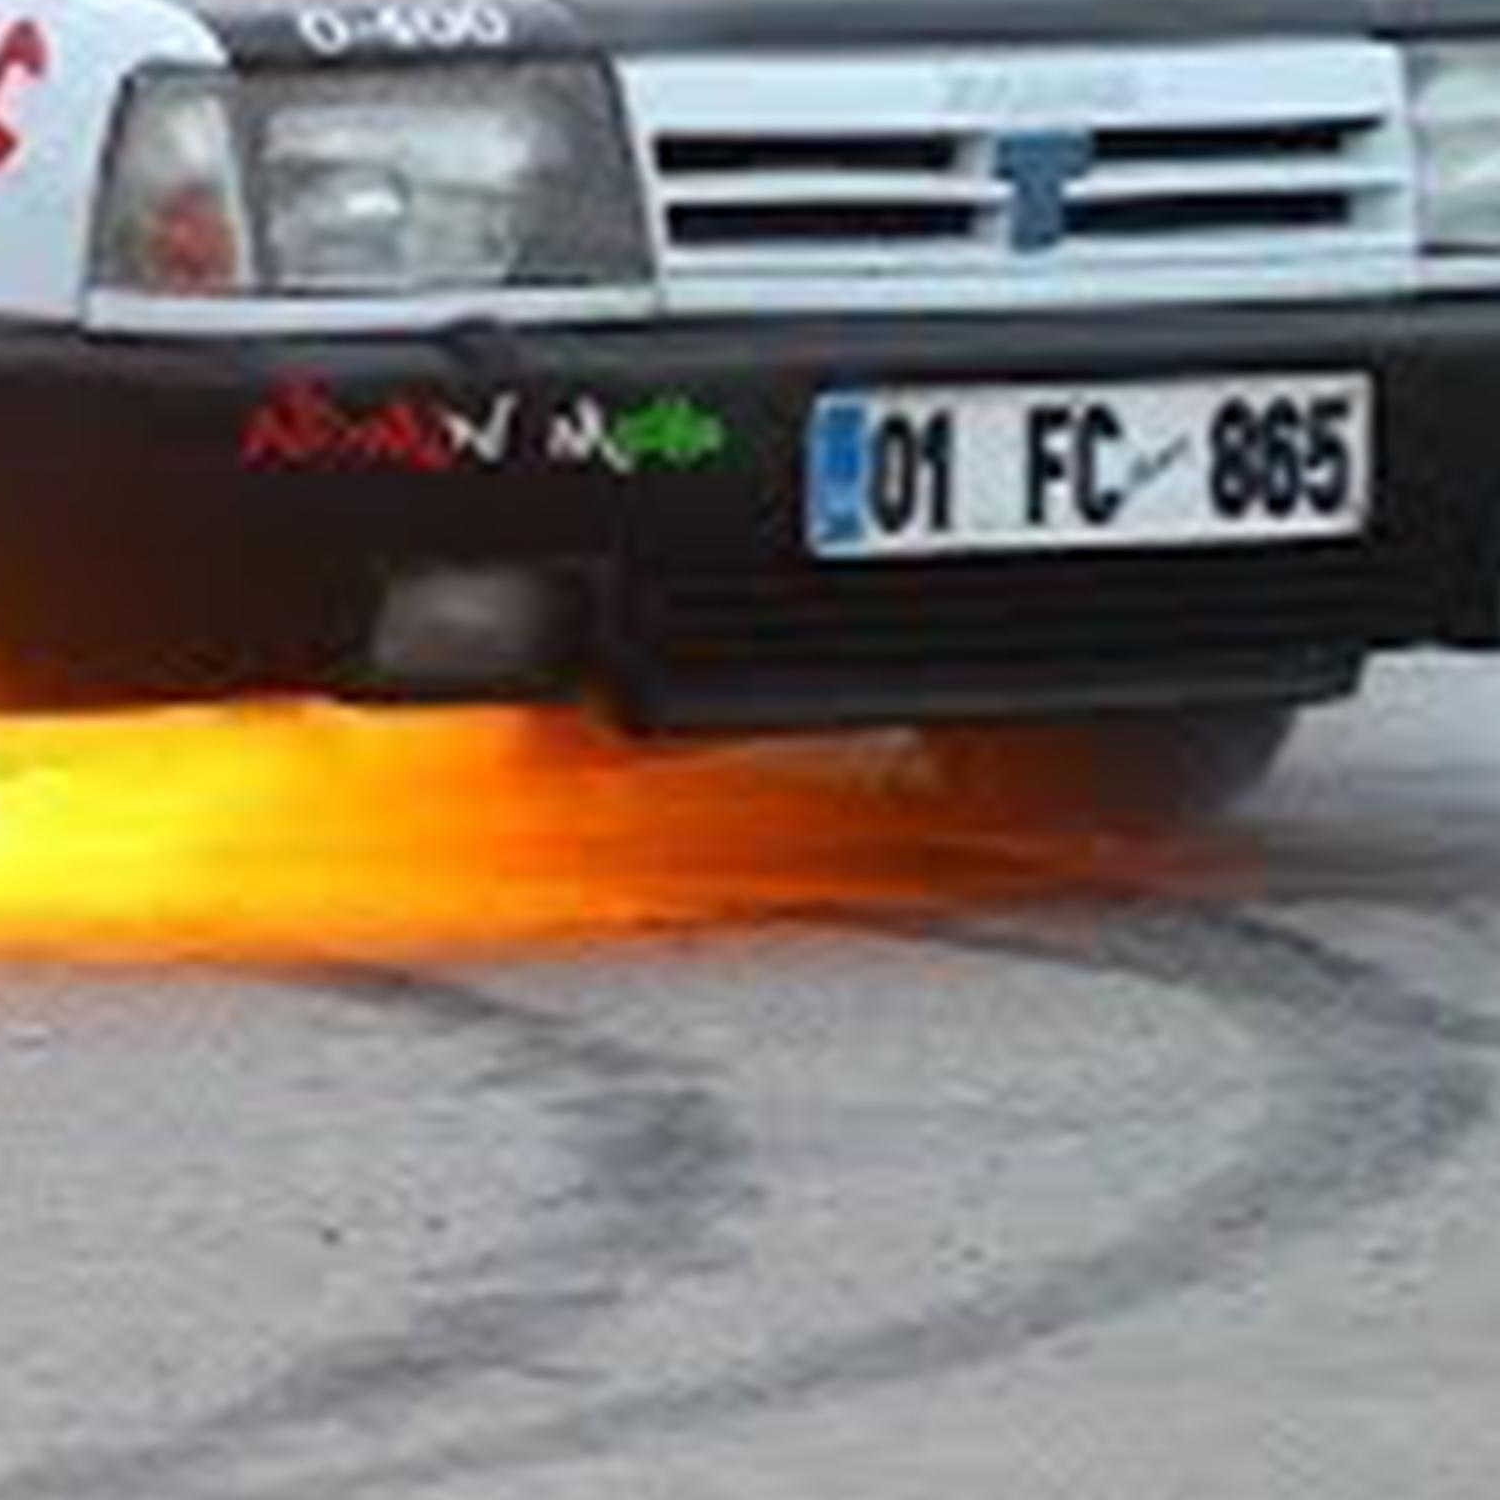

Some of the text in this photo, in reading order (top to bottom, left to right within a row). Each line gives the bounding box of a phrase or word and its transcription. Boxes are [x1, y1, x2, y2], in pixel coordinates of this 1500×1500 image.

[870, 408, 954, 534] 01
[1024, 402, 1124, 528] FC
[1208, 396, 1352, 520] 865
